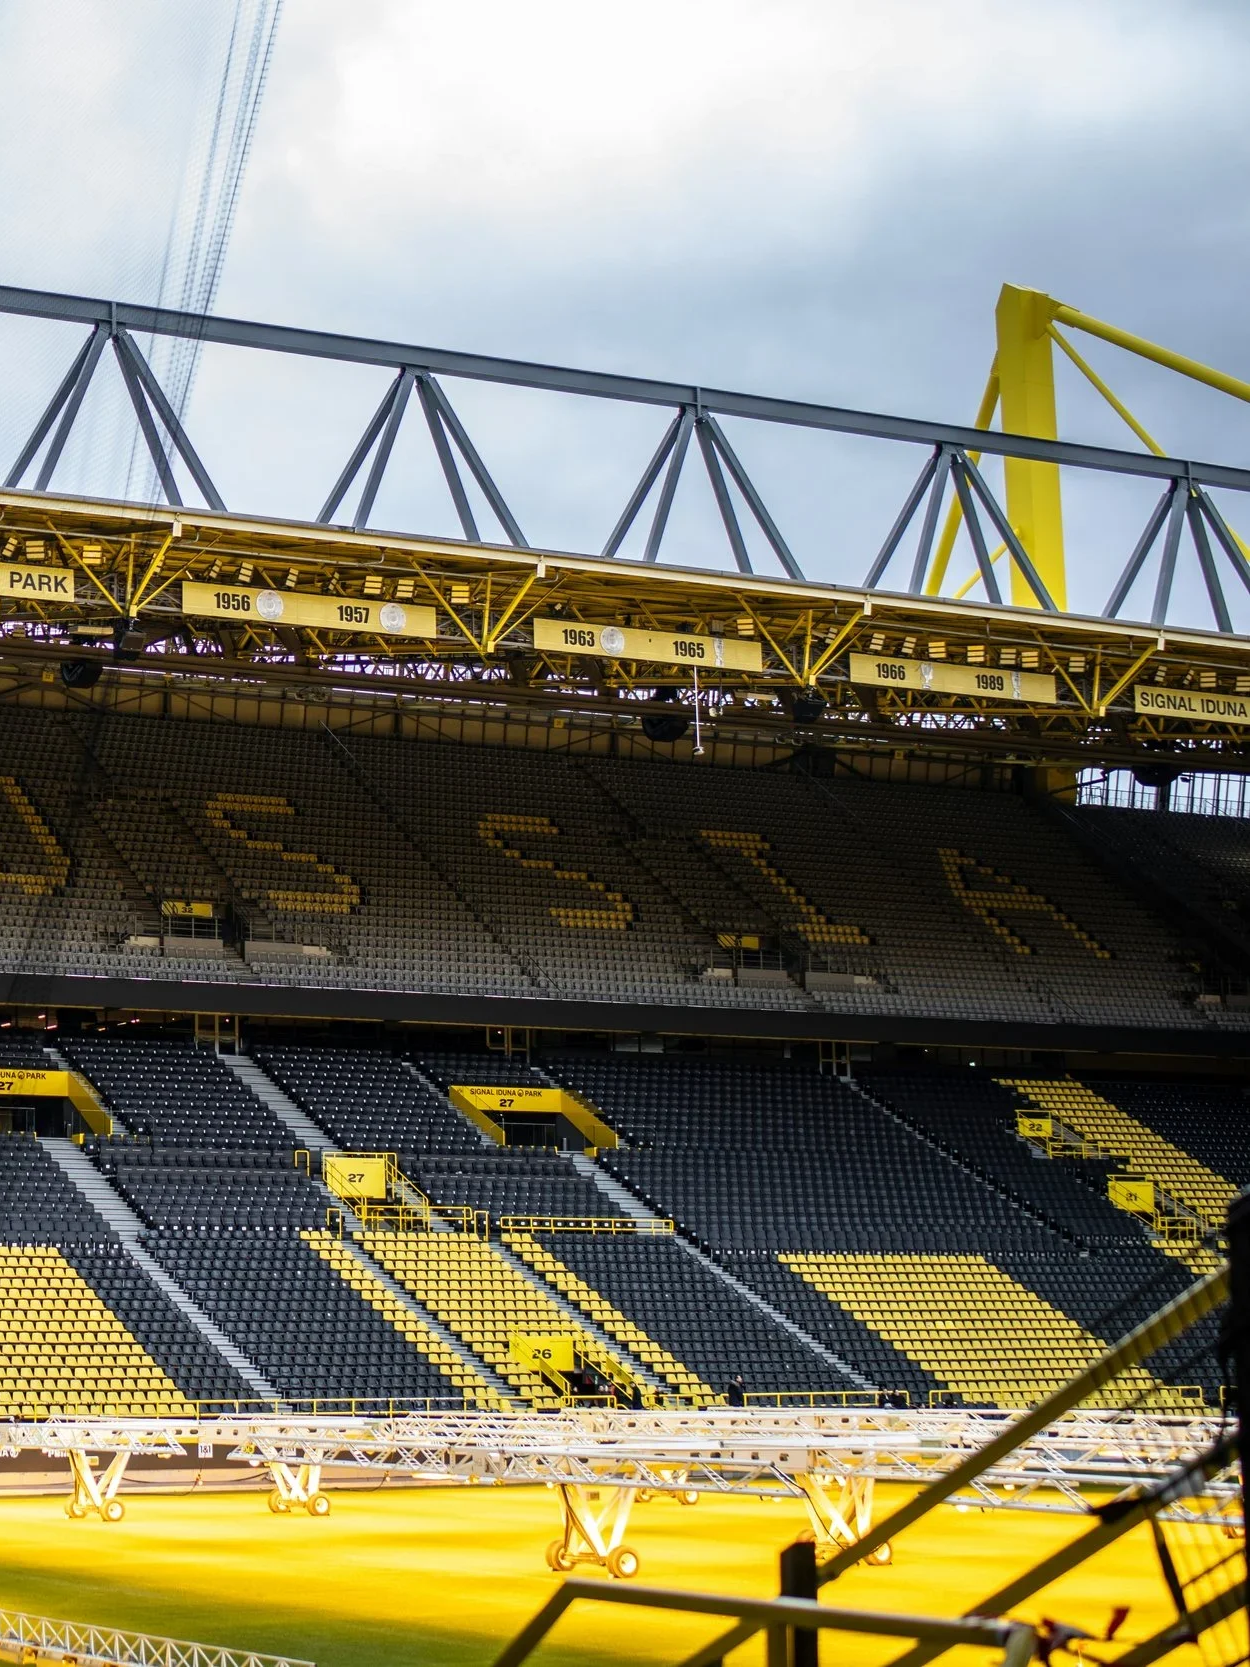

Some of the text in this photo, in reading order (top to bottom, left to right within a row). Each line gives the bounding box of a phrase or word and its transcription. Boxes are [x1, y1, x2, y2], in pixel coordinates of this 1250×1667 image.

[9, 571, 68, 593] PARK
[214, 592, 250, 612] 1956
[337, 605, 370, 624] 1957
[562, 628, 595, 647] 1963
[672, 640, 705, 659] 1965
[875, 663, 906, 681] 1966
[975, 674, 1004, 691] 1989
[1140, 692, 1248, 717] SIGNAL IDUNA
[181, 906, 194, 914] 32
[26, 1072, 46, 1080] PARK
[470, 1088, 494, 1096] SIGNAL
[496, 1089, 516, 1097] IDUNA
[500, 1099, 514, 1107] 27
[348, 1174, 364, 1183] 27
[532, 1349, 552, 1360] 26
[200, 1445, 212, 1453] 1&1
